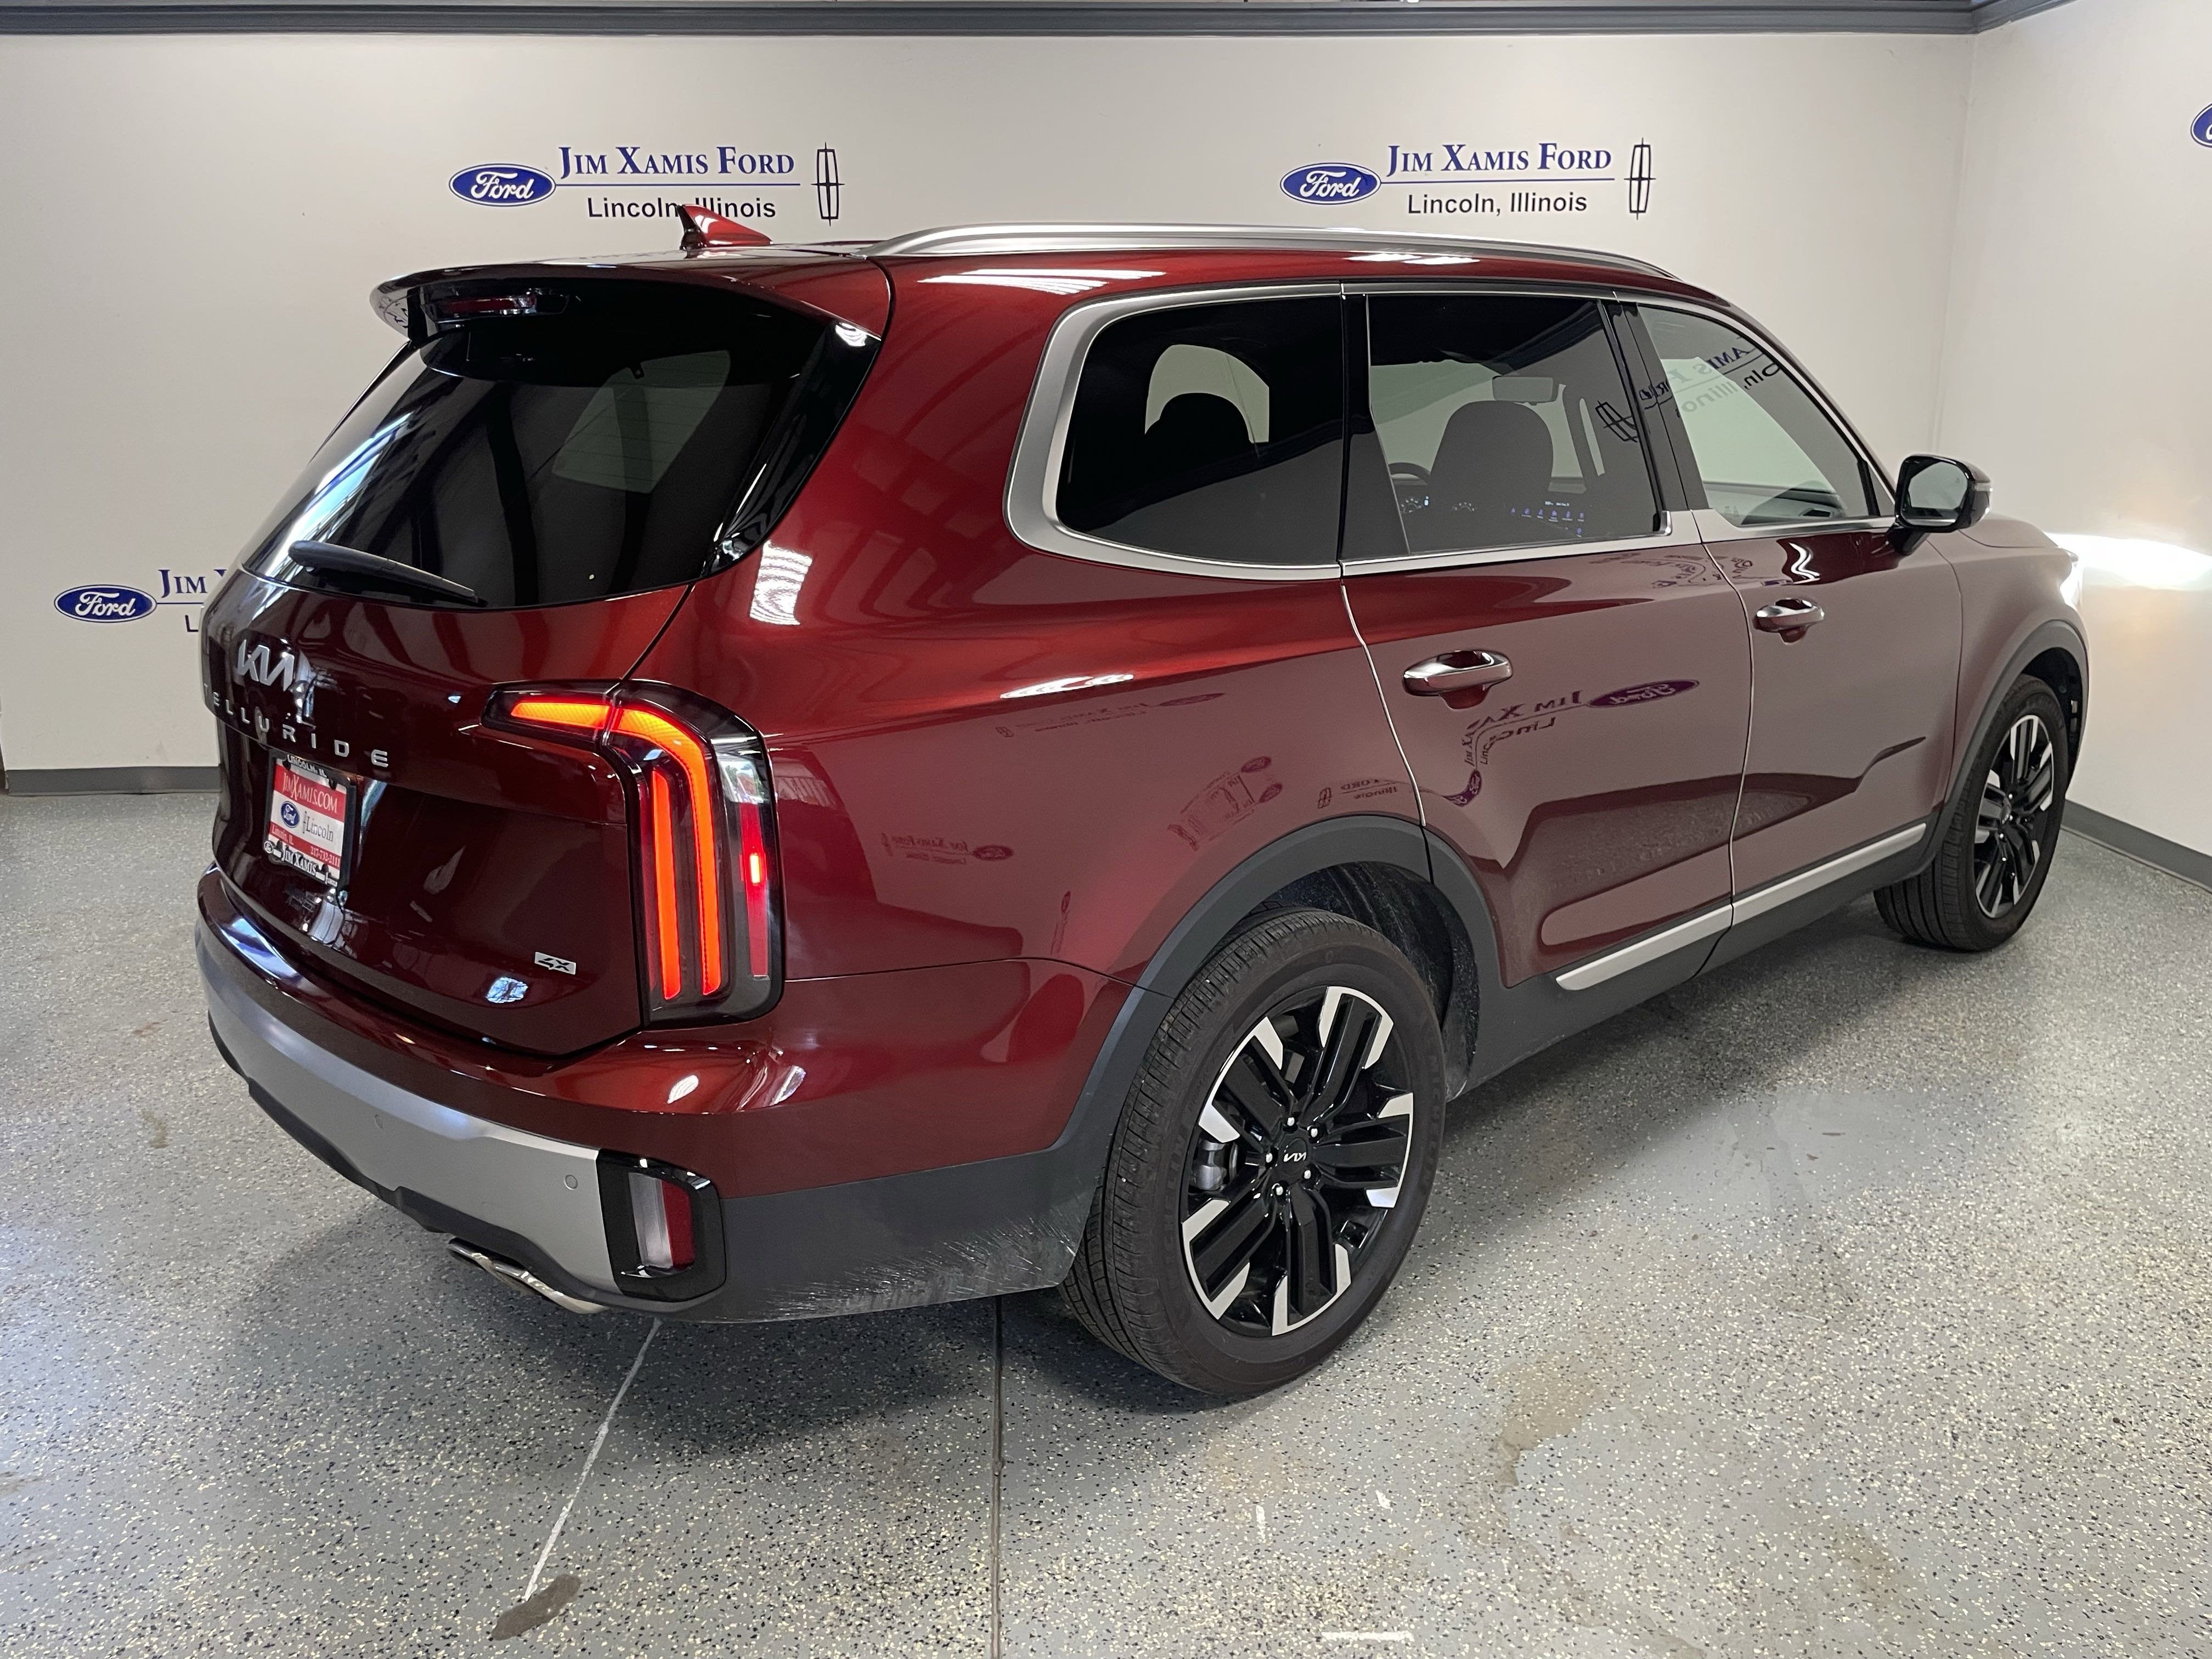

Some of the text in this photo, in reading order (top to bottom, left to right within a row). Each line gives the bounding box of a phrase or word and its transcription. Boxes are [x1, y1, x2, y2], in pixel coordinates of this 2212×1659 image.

[558, 146, 794, 179] JIM XAMIS FORD
[1386, 142, 1612, 177] JIM XAMIS FORD
[470, 171, 534, 200] Ford
[1299, 171, 1360, 199] Ford
[1408, 192, 1587, 216] Lincoln, Illinois
[157, 569, 208, 599] JIM
[75, 591, 136, 617] Ford
[306, 815, 334, 842] Lincoln
[281, 845, 294, 865] JIM
[294, 853, 317, 876] XAMIS
